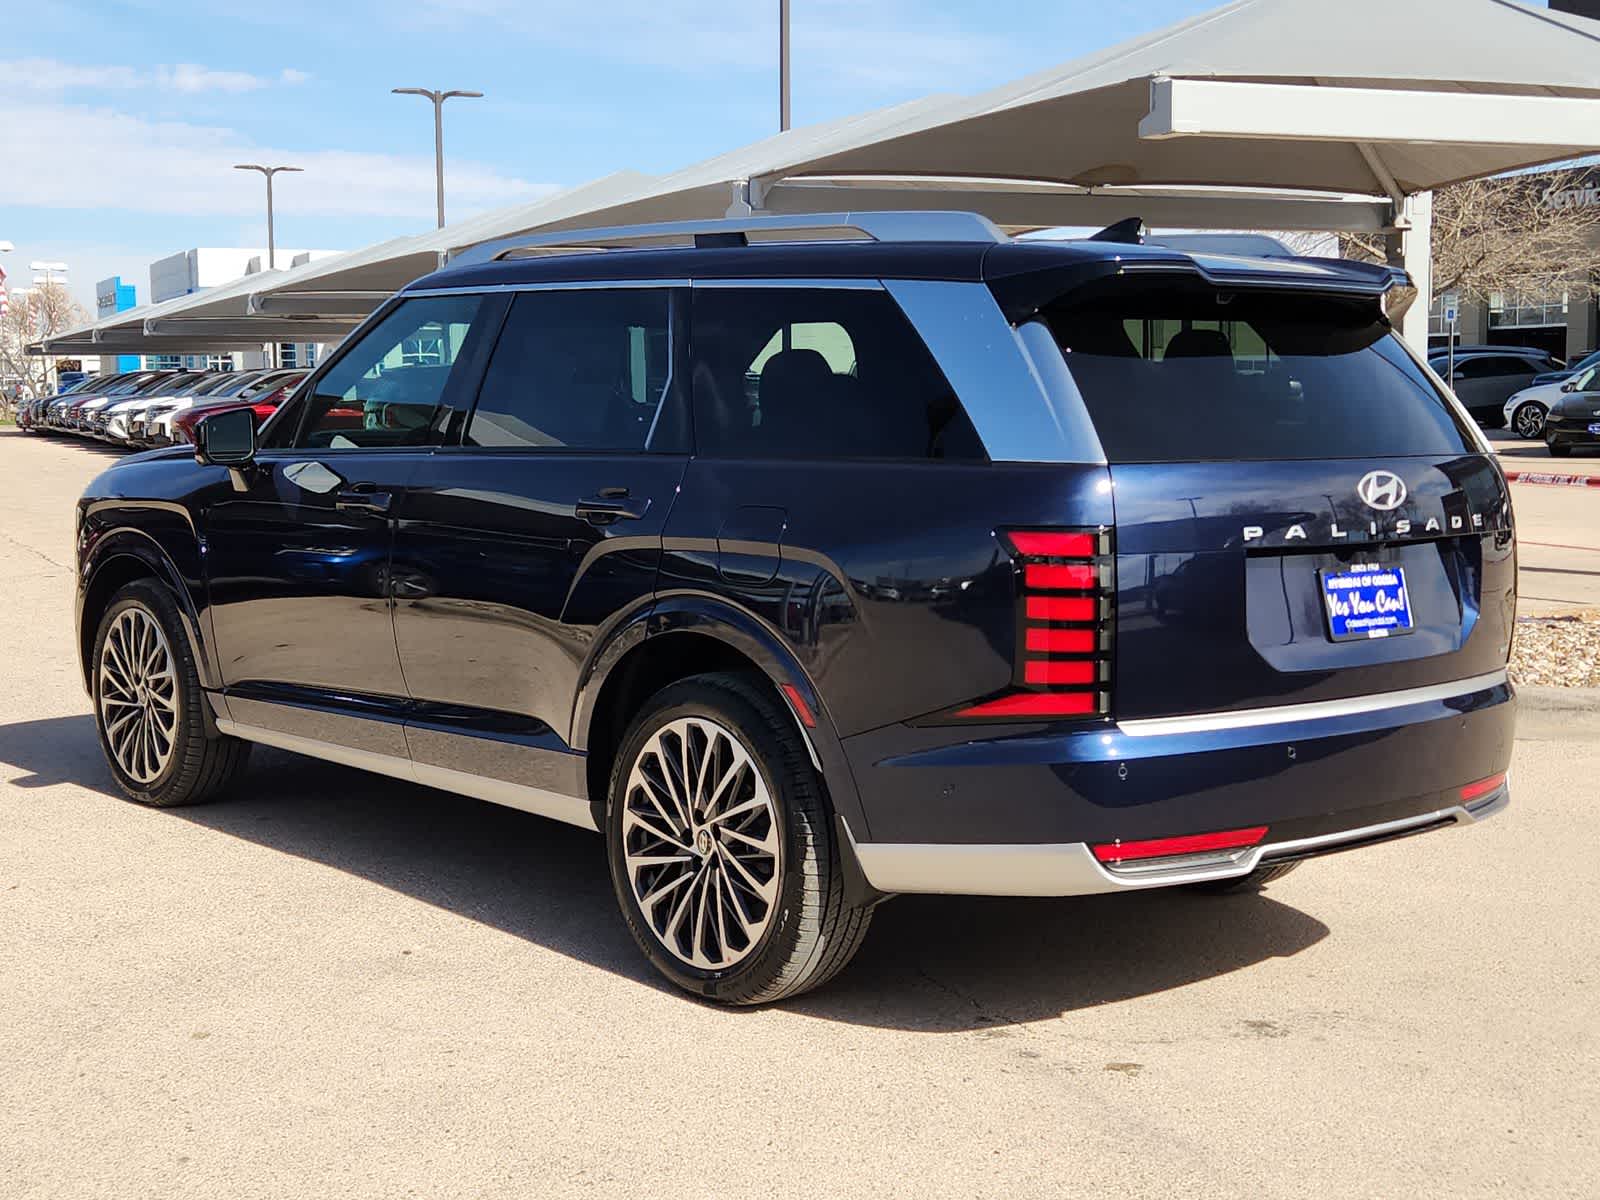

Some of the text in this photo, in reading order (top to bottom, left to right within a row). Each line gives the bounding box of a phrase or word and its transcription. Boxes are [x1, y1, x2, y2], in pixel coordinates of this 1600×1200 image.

[1243, 513, 1483, 541] PALISADE
[1327, 587, 1405, 617] Yes You Can!
